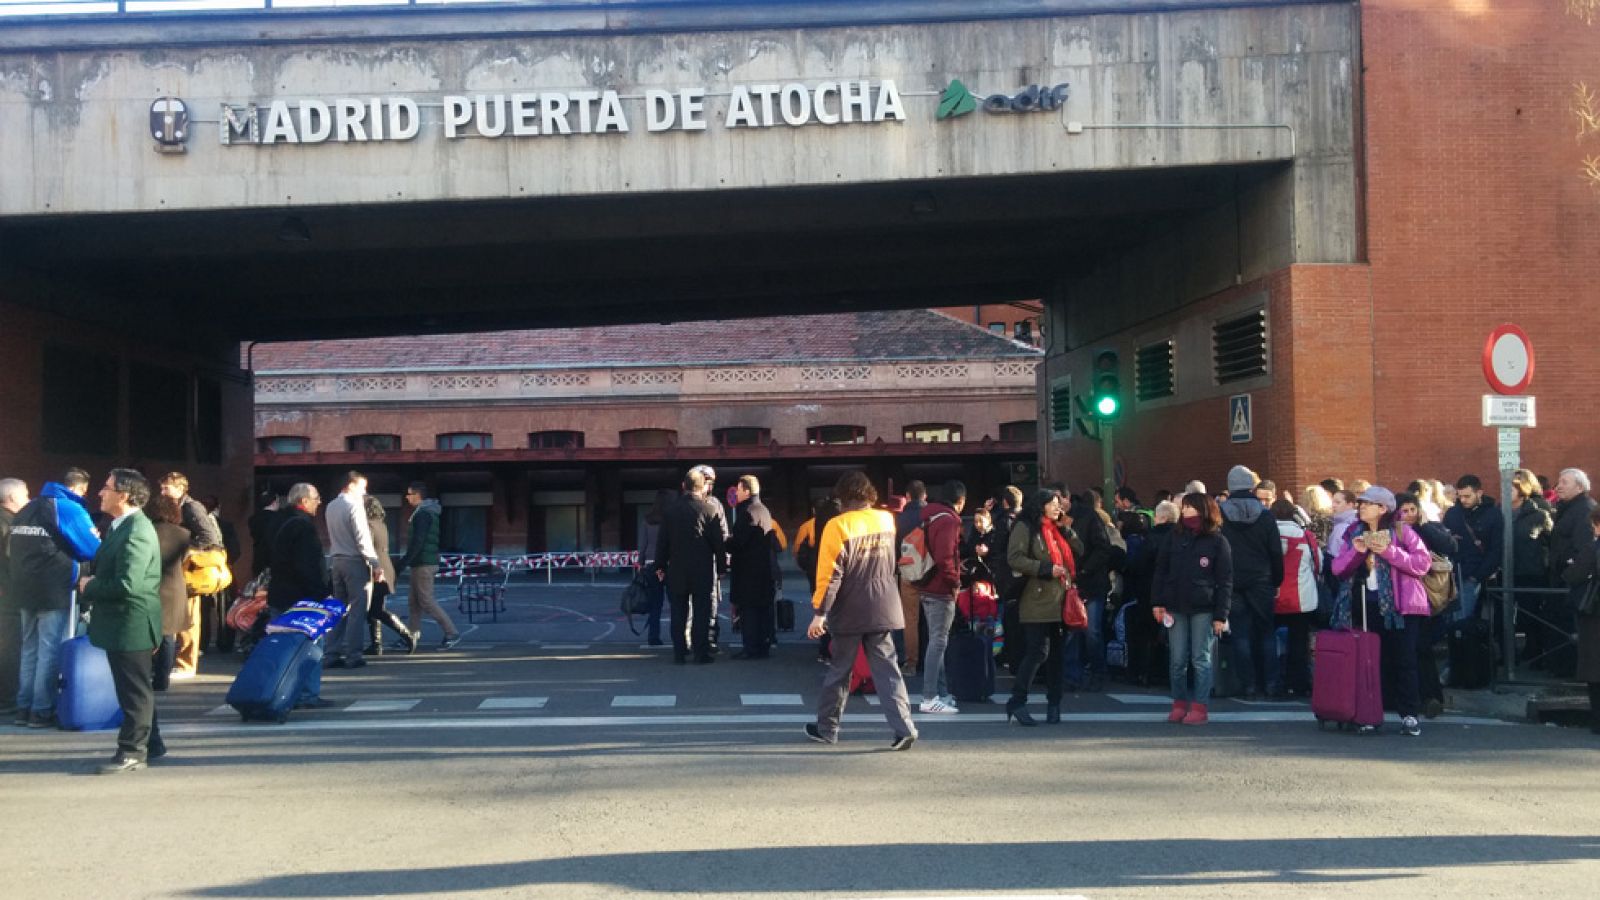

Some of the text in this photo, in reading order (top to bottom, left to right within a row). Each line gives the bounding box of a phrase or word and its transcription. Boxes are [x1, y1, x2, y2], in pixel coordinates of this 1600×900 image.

[220, 79, 906, 146] MADRID PUERTA DE ATOCHA
[984, 82, 1070, 114] adif
